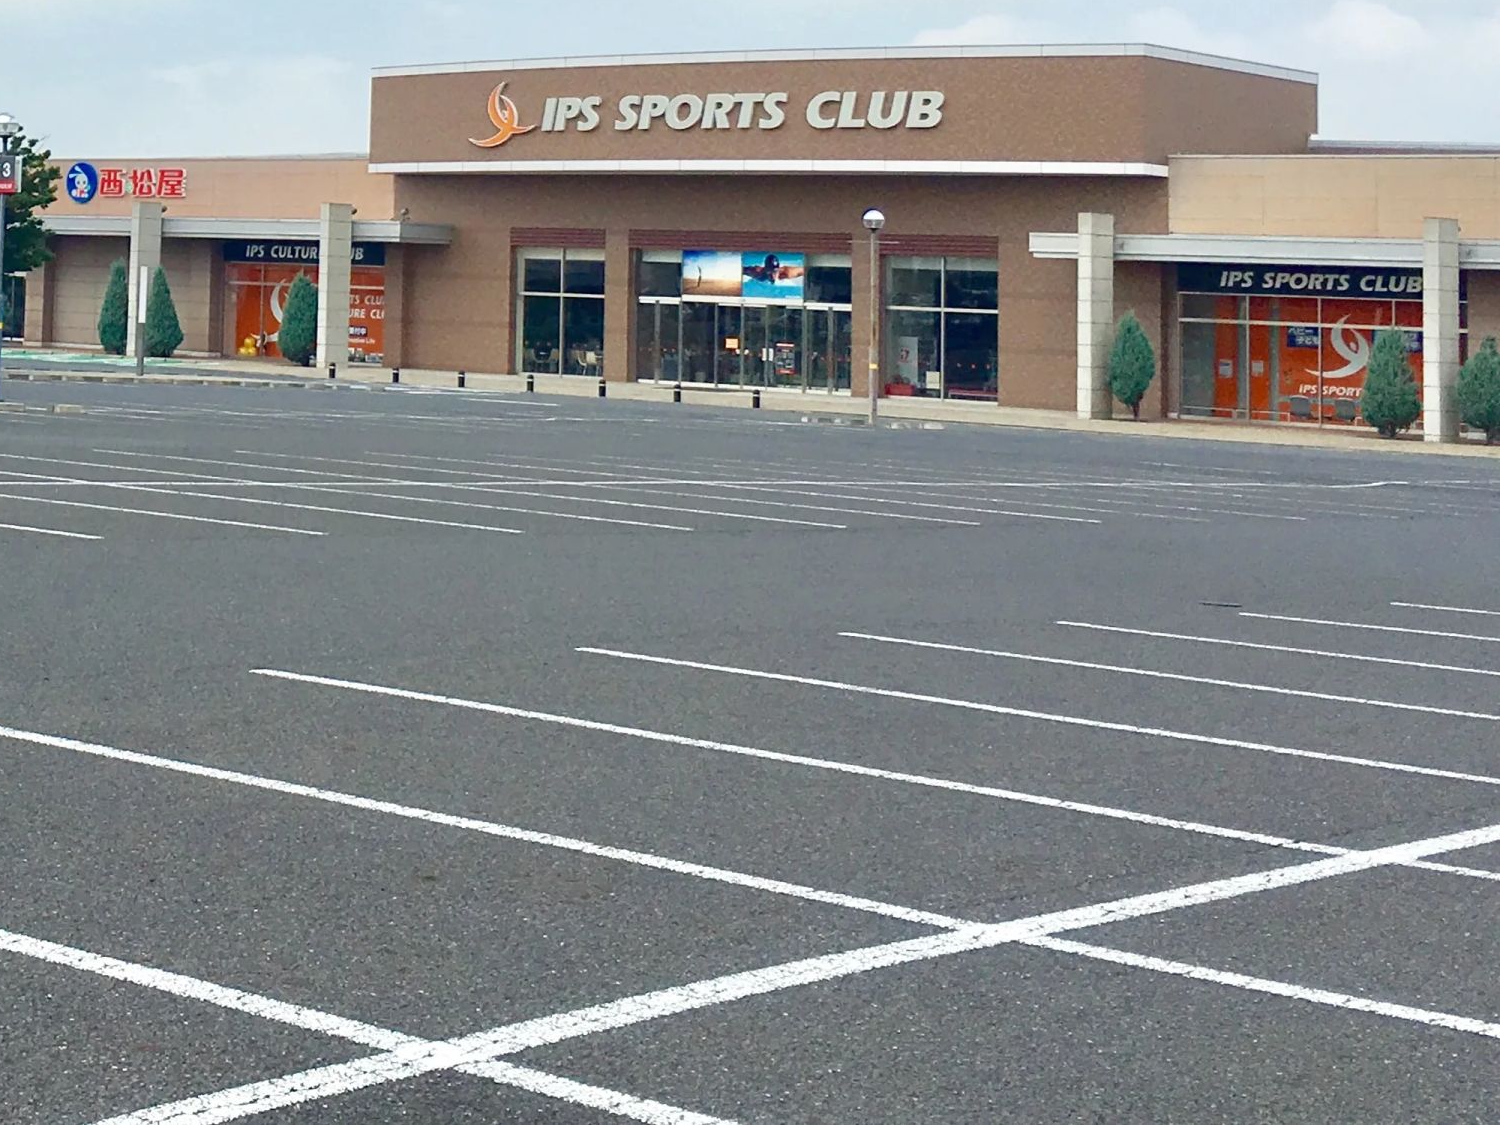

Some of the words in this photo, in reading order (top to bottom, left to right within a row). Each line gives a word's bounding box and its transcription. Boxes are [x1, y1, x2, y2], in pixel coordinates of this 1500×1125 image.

[541, 96, 602, 132] IPS
[614, 92, 788, 131] SPORTS
[806, 90, 946, 130] CLUB
[100, 168, 186, 198] 西松屋
[246, 245, 264, 258] IPS
[270, 246, 319, 260] CULTUR
[1220, 271, 1254, 287] IPS
[1262, 272, 1350, 291] SPORTS
[1360, 275, 1423, 293] CLUB
[1299, 383, 1318, 394] IPS
[1322, 385, 1363, 397] SPORT
